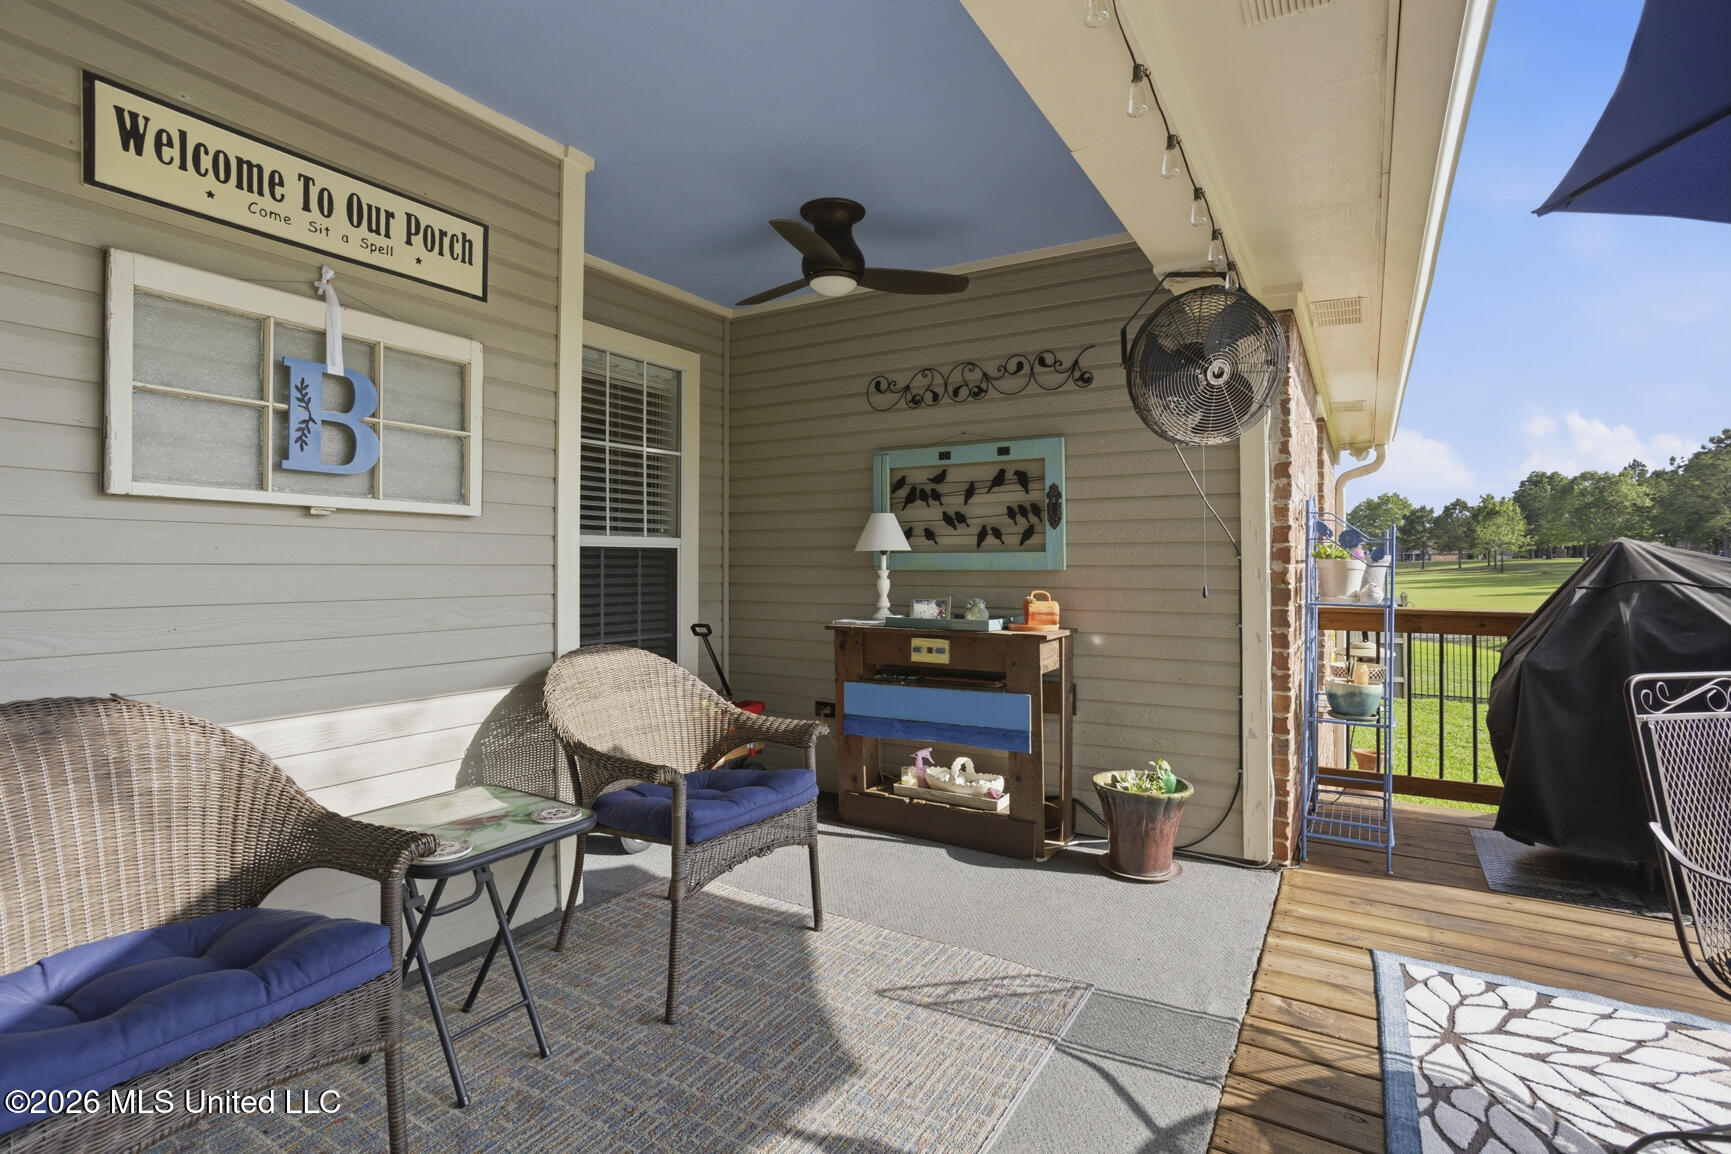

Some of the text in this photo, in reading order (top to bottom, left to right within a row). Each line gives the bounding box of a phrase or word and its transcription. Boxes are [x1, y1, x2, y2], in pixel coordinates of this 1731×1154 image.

[112, 104, 474, 267] Welcome To Our Porch
[247, 201, 394, 257] Come Sit a Spell
[281, 355, 381, 475] B
